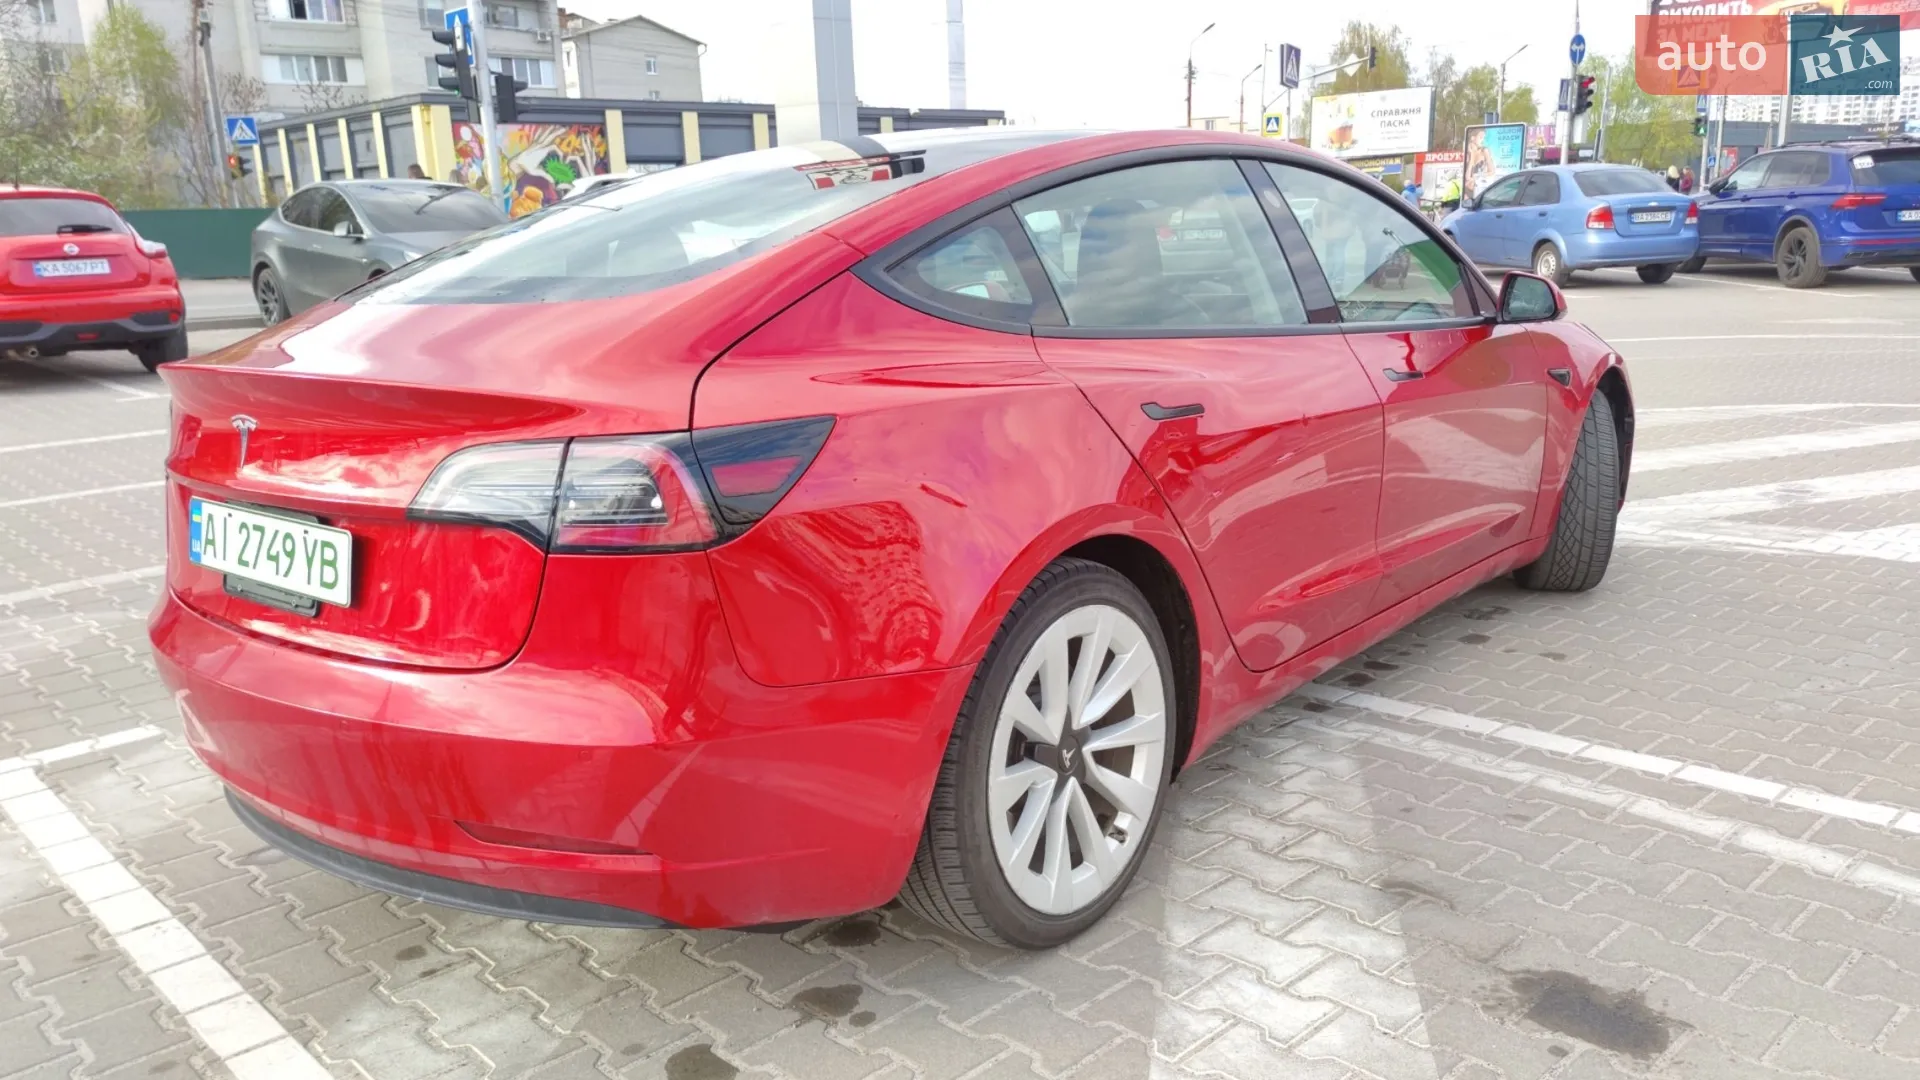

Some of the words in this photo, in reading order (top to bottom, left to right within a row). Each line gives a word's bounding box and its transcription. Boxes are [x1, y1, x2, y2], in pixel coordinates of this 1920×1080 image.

[1370, 106, 1422, 118] СПРАВЖНЯ
[1379, 118, 1411, 129] ПАСКА
[1425, 152, 1466, 163] ПРОДУК
[43, 263, 60, 274] KA
[62, 262, 88, 273] 5067
[237, 521, 296, 579] 2749
[303, 534, 339, 590] YB
